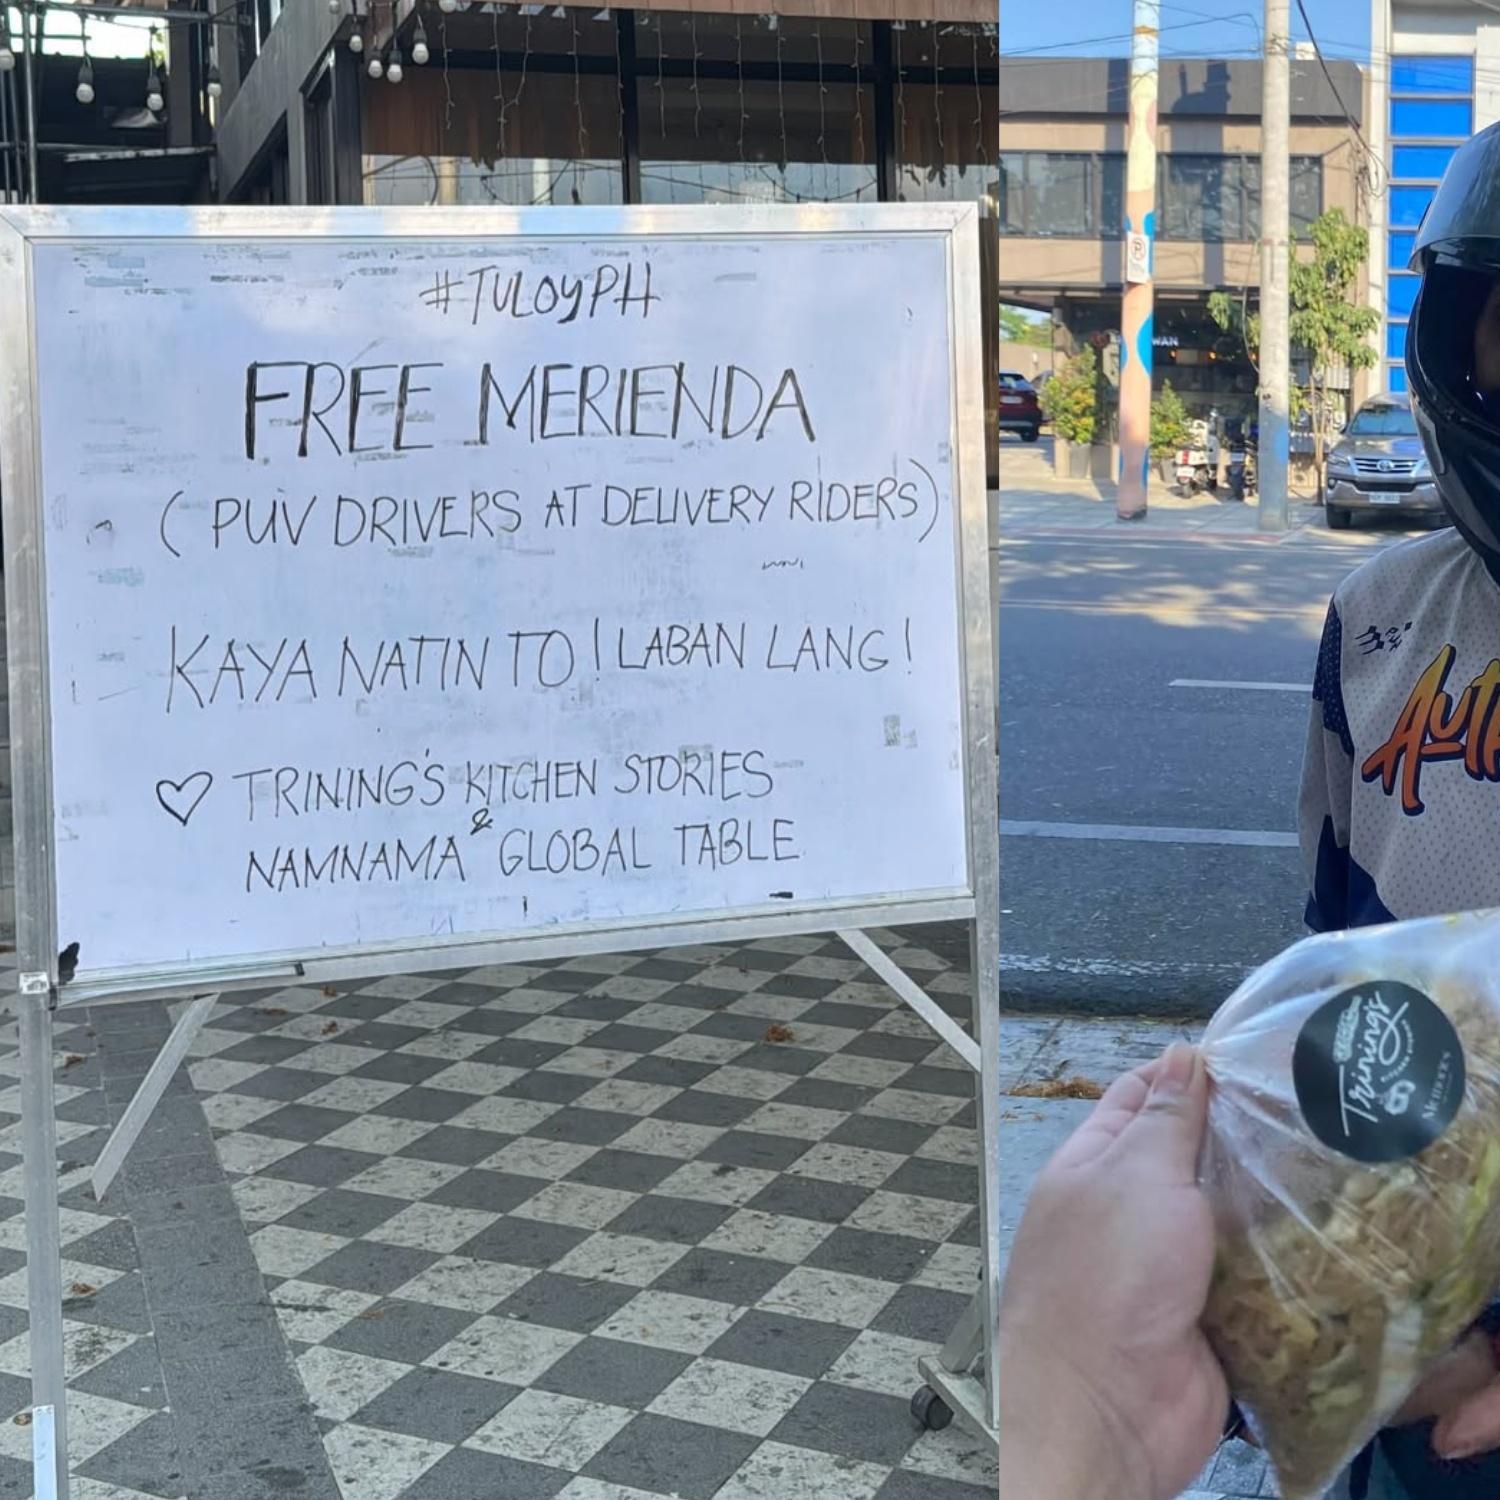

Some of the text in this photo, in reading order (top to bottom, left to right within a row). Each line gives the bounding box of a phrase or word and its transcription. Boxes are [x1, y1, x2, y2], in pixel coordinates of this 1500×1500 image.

[245, 360, 816, 460] FREE MERIENDA
[211, 494, 317, 549] PUV
[334, 490, 522, 546] DRIVERS
[544, 483, 592, 529] AT
[601, 482, 775, 527] DELIVERY
[166, 625, 318, 713] KAYA
[338, 636, 490, 696] NATIN
[618, 622, 746, 669] LABAN
[231, 748, 774, 821] TRINING'S KITCHEN STORIES
[246, 808, 801, 893] NAMNAMA & GLOBAL TABLE
[1338, 990, 1410, 1138] Trining's
